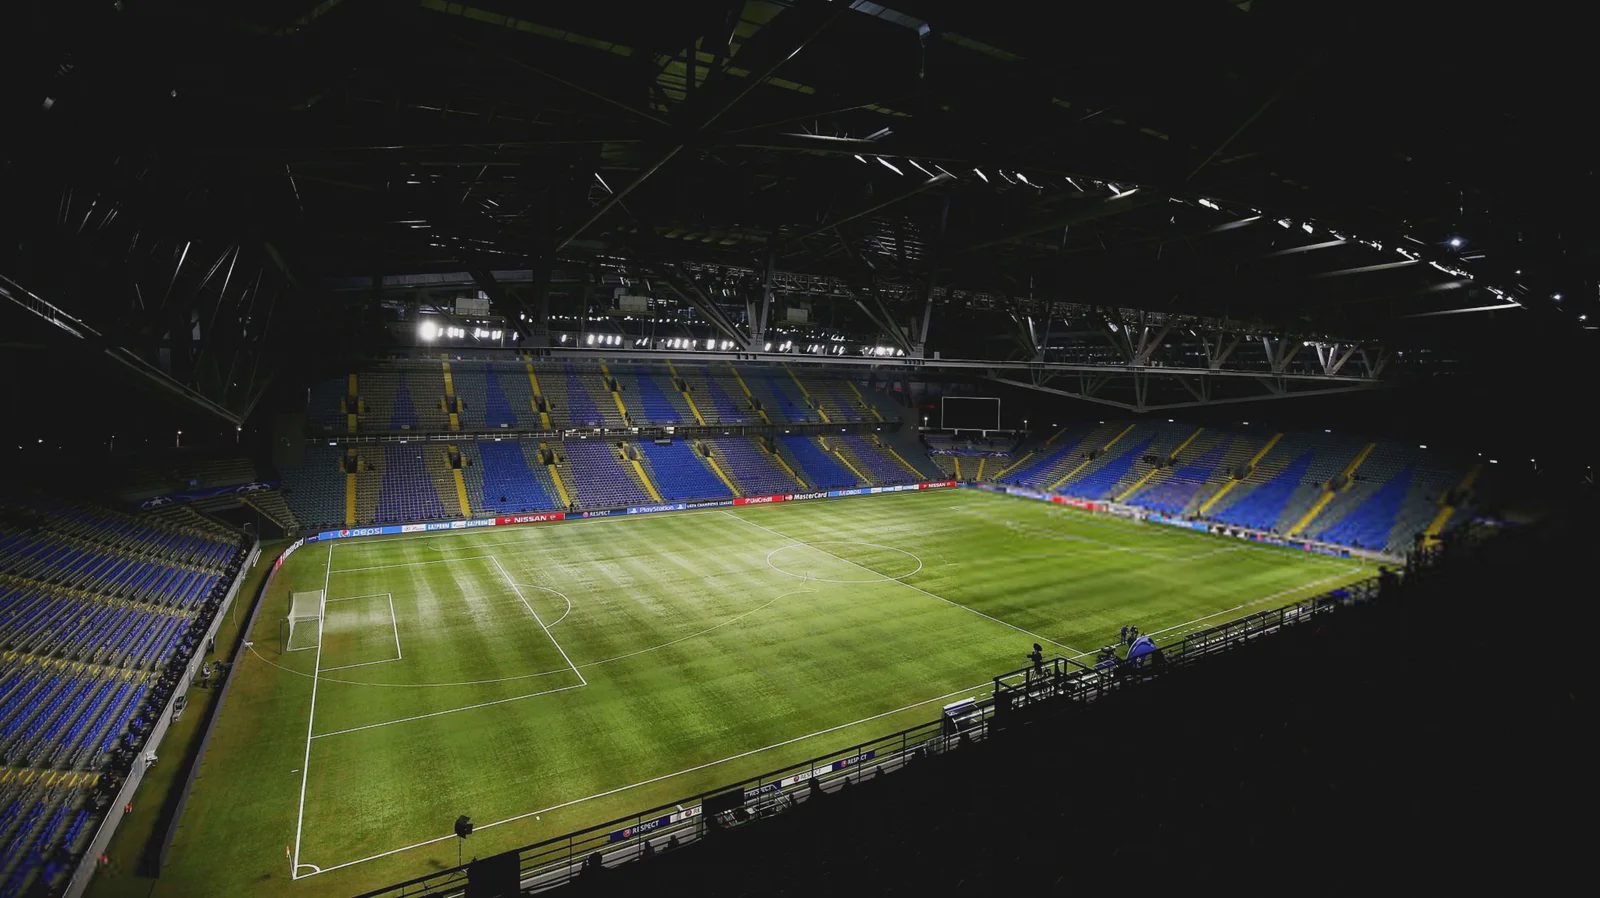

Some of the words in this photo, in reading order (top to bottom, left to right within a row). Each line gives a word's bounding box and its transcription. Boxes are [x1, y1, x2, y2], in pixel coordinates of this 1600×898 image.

[794, 492, 828, 500] MasterCard
[514, 515, 547, 523] NISSAN
[352, 527, 382, 537] pepsi
